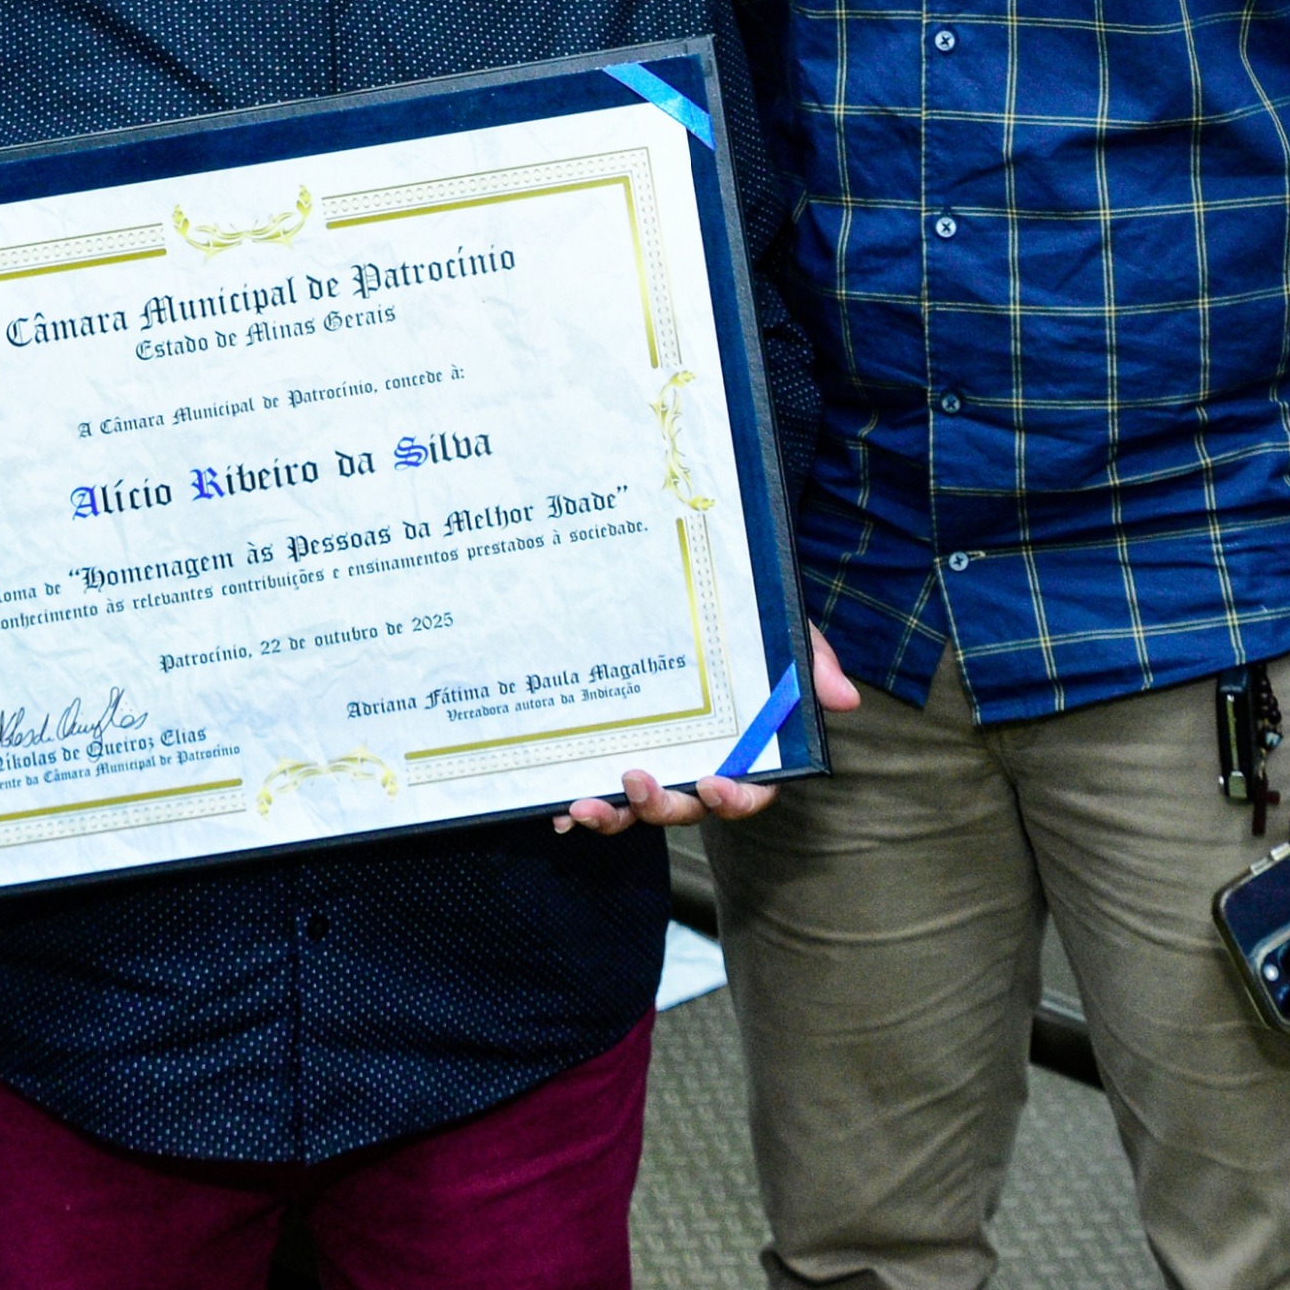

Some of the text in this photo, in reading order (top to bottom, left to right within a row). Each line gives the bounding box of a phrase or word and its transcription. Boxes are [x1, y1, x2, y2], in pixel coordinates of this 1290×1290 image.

[5, 244, 516, 348] Câmara Municipal de Patrocínio
[135, 304, 397, 362] Estado de Minas Gerais
[77, 363, 465, 439] A Câmara Municipal de Patrocínio, concede à:
[69, 431, 494, 521] Alício Ribeiro da Silva
[43, 582, 62, 597] de
[246, 541, 274, 566] às
[286, 525, 392, 564] Pessoas
[401, 520, 432, 541] da
[443, 504, 535, 538] Melhor
[105, 598, 125, 615] às
[132, 586, 214, 610] relevantes
[221, 568, 325, 597] contribuições
[332, 567, 340, 580] e
[347, 548, 459, 578] ensinamentos
[466, 534, 545, 562] prestados
[552, 529, 562, 546] à
[569, 520, 649, 543] sociedade.
[159, 611, 454, 674] Patrocínio, 22 de outubro de 2025
[346, 654, 687, 720] Adriana Fátima de Paula Magalhães
[445, 682, 641, 723] Vereadora autora da Indicação
[25, 775, 40, 787] da
[42, 768, 92, 784] Câmara
[95, 755, 157, 778] Municipal
[158, 754, 173, 767] de
[176, 744, 241, 766] Patrocínio
[60, 746, 80, 762] de
[85, 736, 155, 763] Queiroz
[159, 726, 207, 748] Elias
